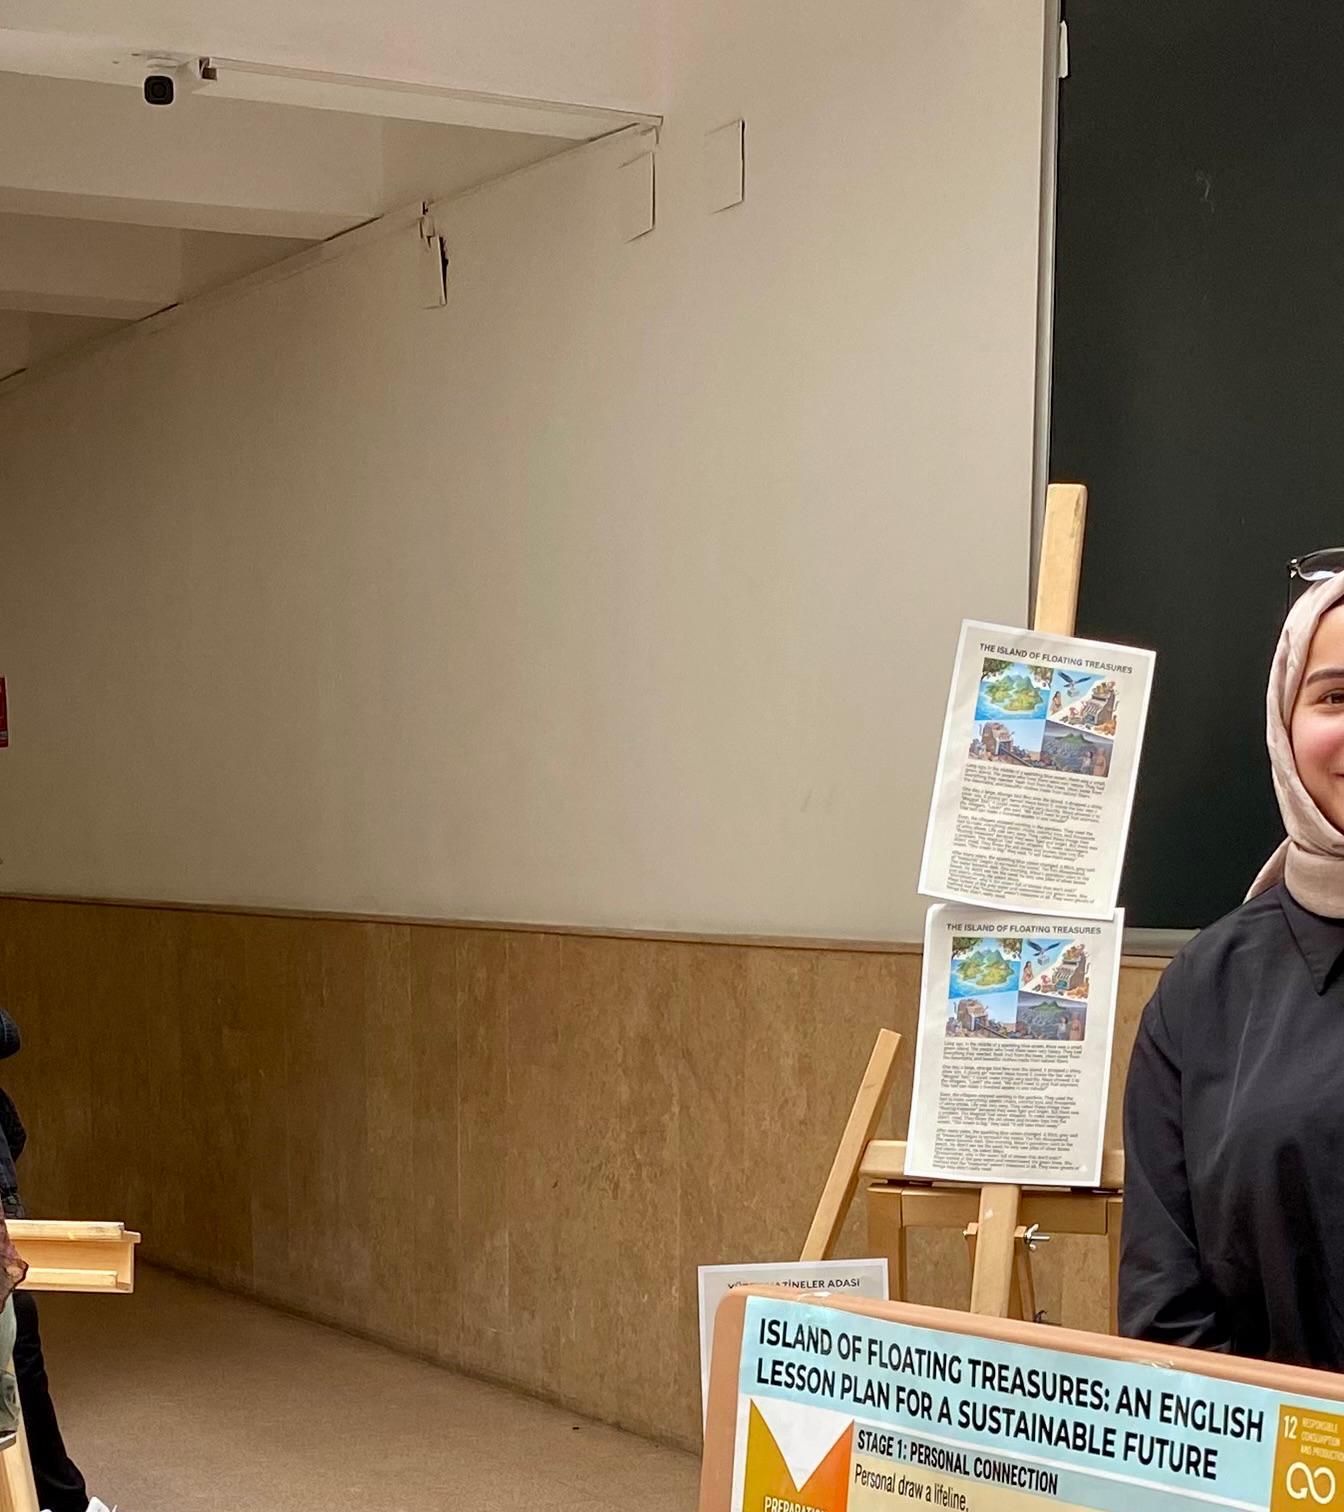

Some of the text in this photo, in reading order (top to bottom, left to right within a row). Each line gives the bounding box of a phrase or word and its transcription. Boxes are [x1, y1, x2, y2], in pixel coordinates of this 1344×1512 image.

[980, 643, 1133, 674] THE ISLAND OF FLOATING TREASURES
[947, 923, 1101, 934] THE ISLAND OF FLOATING TREASURES
[827, 1277, 860, 1289] ADASI
[759, 1317, 832, 1355] ISLAND
[837, 1332, 862, 1361] OF
[867, 1338, 961, 1384] FLOATING
[967, 1358, 1109, 1412] TREASURES:
[1115, 1385, 1151, 1419] AN
[1159, 1391, 1263, 1442] ENGLISH
[756, 1357, 1217, 1480] LESSON PLAN FOR A SUSTAINABLE FUTURE
[1283, 1415, 1297, 1439] 12
[857, 1429, 1058, 1495] STAGE 1: PERSONAL CONNECTION
[854, 1463, 968, 1512] Personal draw a lifeline.
